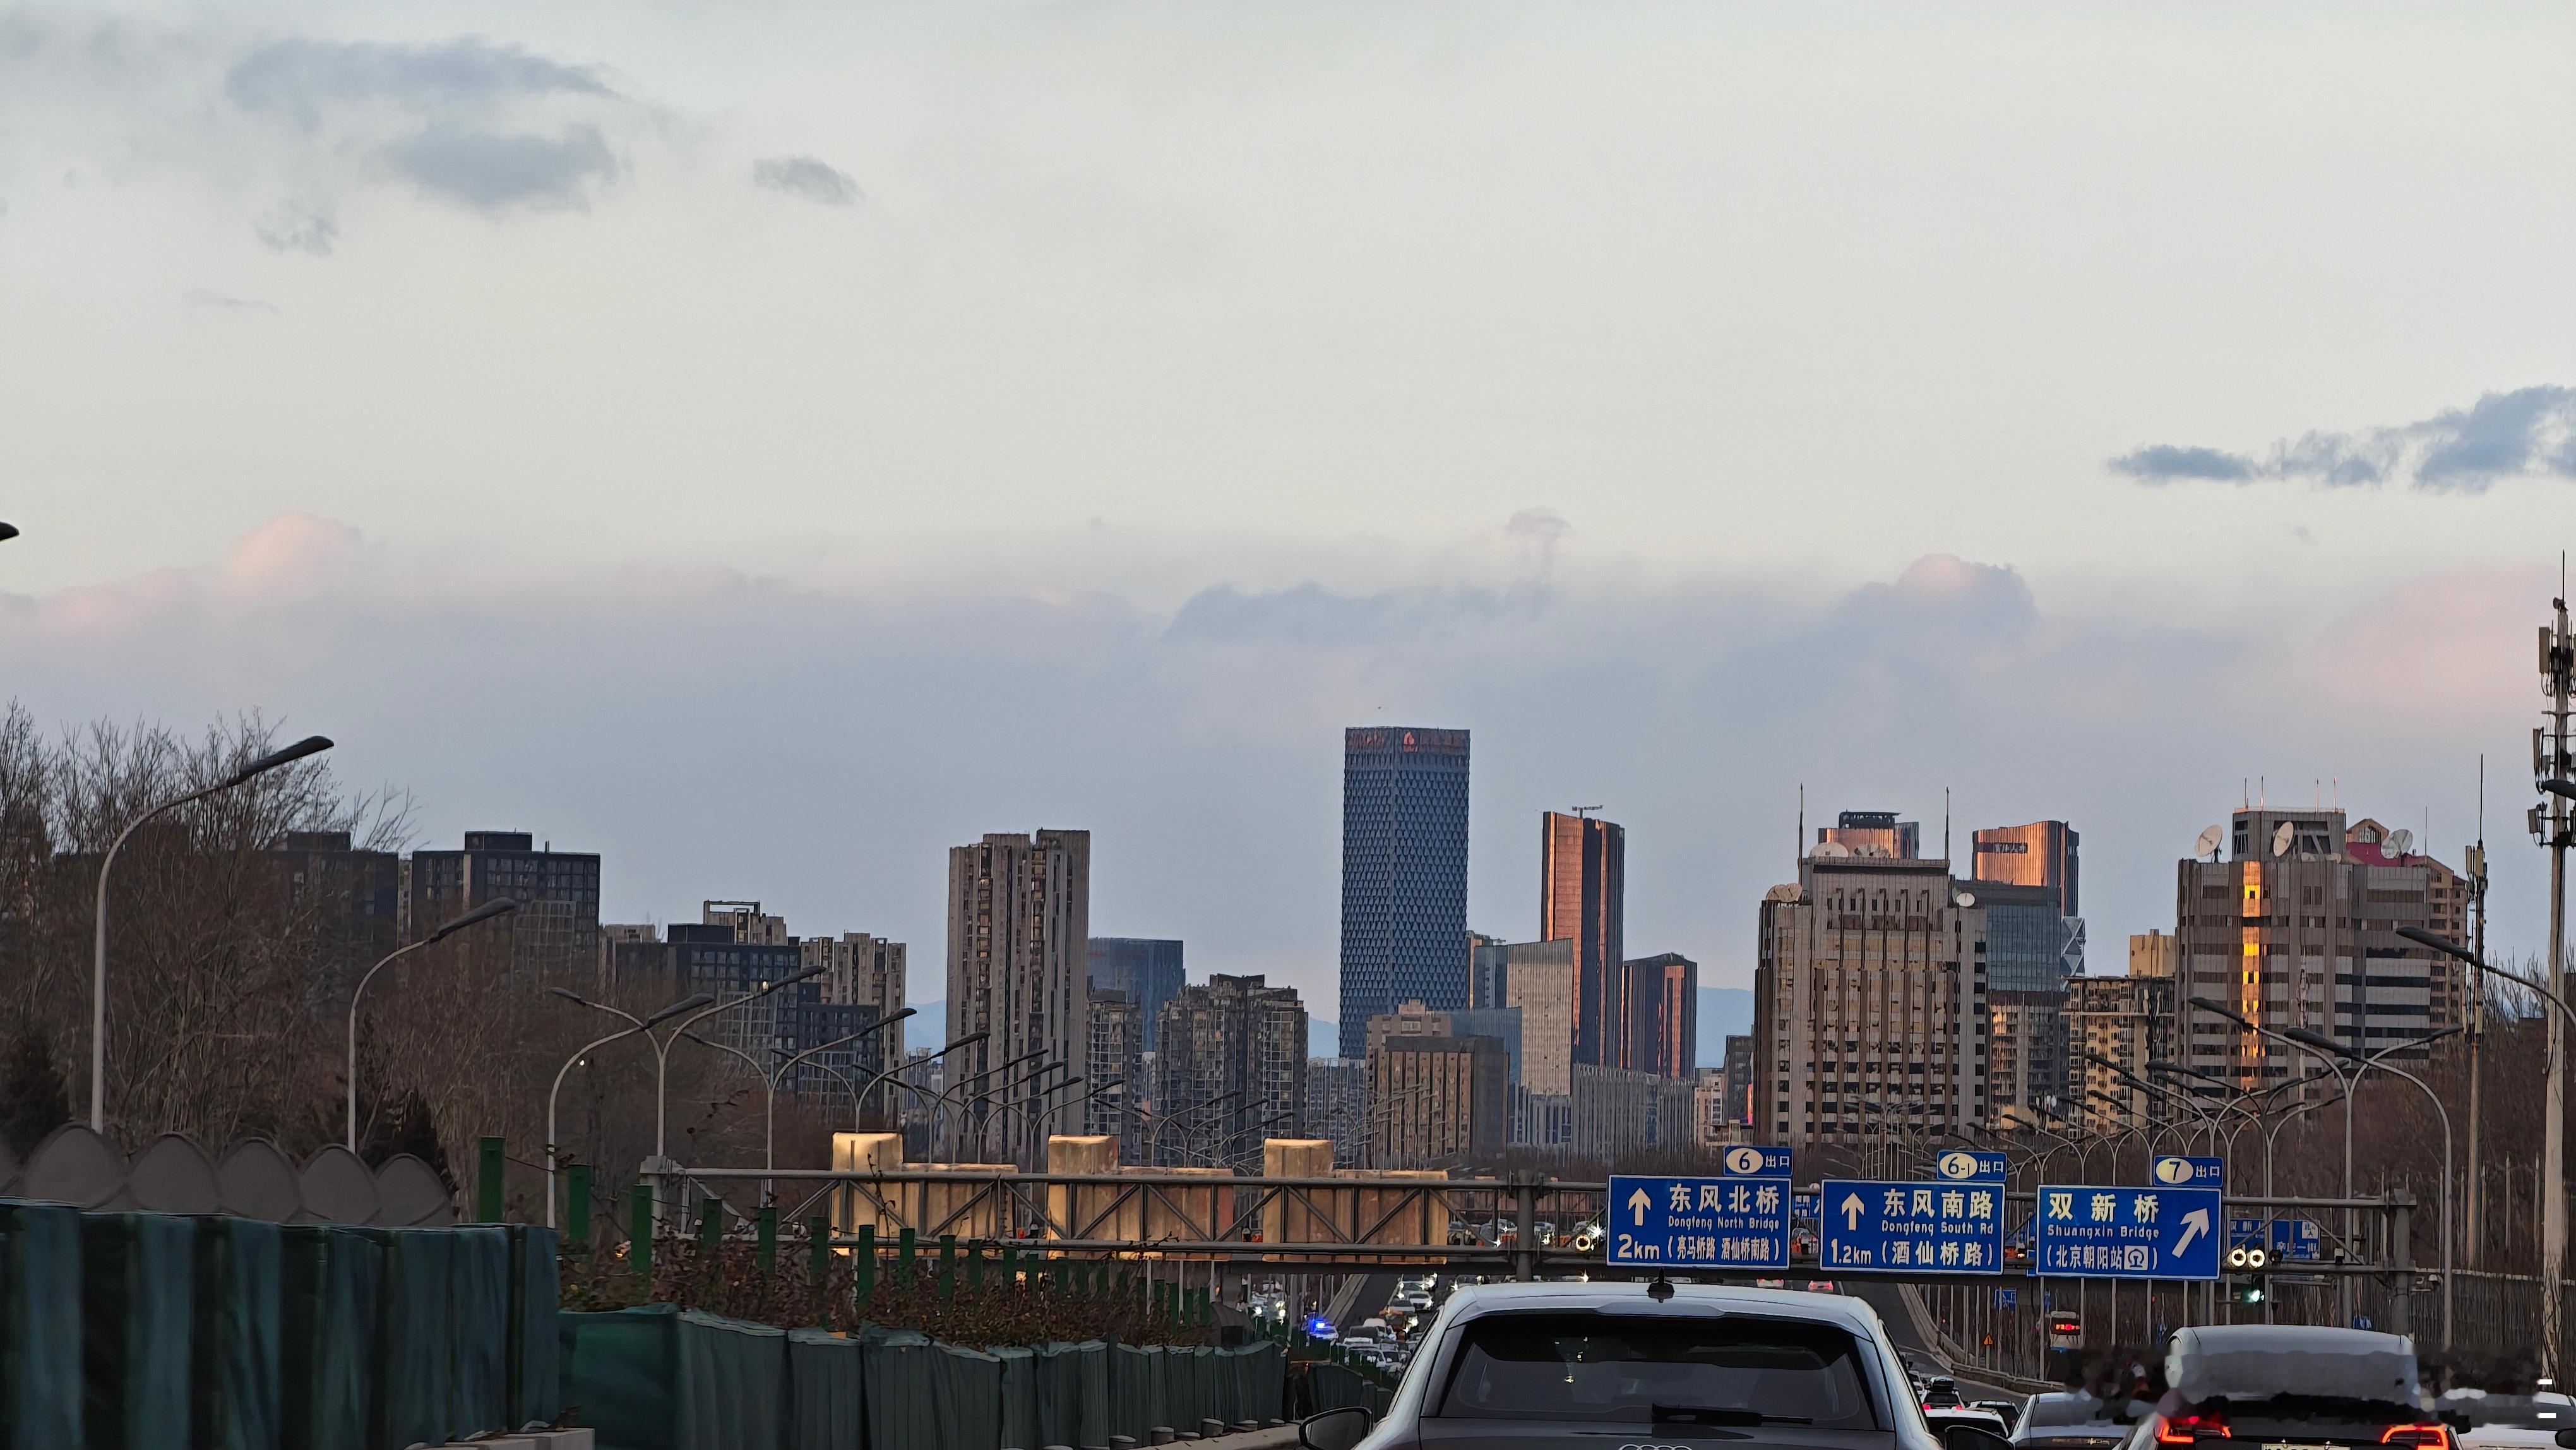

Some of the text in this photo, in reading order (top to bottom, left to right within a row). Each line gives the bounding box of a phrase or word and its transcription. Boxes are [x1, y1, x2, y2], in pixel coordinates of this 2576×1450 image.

[1739, 1151, 1790, 1170] 6 出口
[1948, 1156, 2004, 1176] 6-1 出口
[2169, 1161, 2220, 1180] 7 出口
[1669, 1183, 1779, 1214] 东风北桥
[1883, 1188, 1993, 1219] 东风南路
[2048, 1192, 2159, 1223] 双新桥
[1668, 1215, 1779, 1232] Dongfeng North Bridge
[1882, 1219, 1993, 1237] Dongfeng South Rd
[2048, 1224, 2159, 1242] Shuangxin Bridge
[1618, 1233, 1660, 1260] 2km
[1831, 1238, 1872, 1265] 1.2km
[1882, 1240, 1993, 1266] (酒仙桥路)
